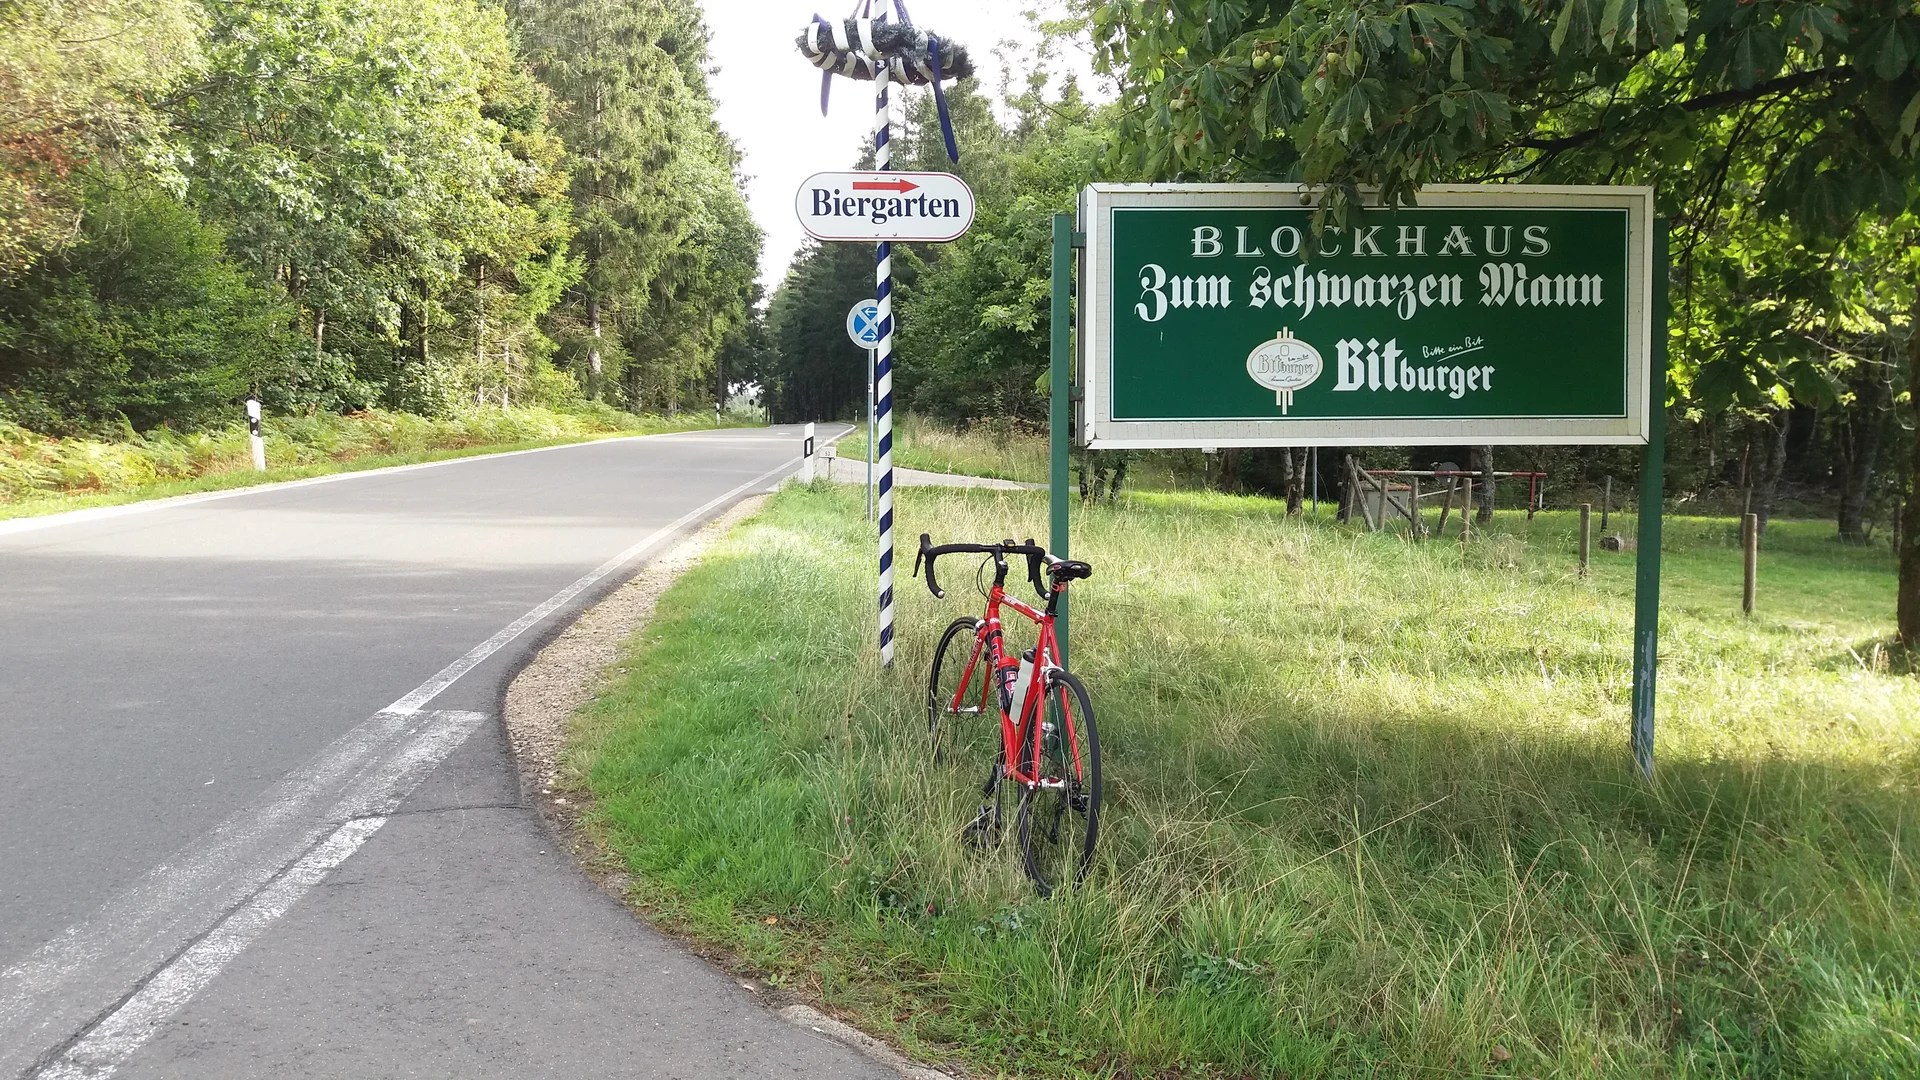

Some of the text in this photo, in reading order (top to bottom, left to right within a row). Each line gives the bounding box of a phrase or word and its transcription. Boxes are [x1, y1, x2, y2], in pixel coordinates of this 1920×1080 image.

[811, 188, 961, 225] Biergarten
[1191, 225, 1551, 258] BLOCKHAUS
[1134, 263, 1234, 323] Zum
[1478, 262, 1605, 308] Mann
[1422, 335, 1484, 359] Bitte ein Bit
[1257, 354, 1314, 377] Bitburger
[1332, 337, 1496, 400] Bitburger
